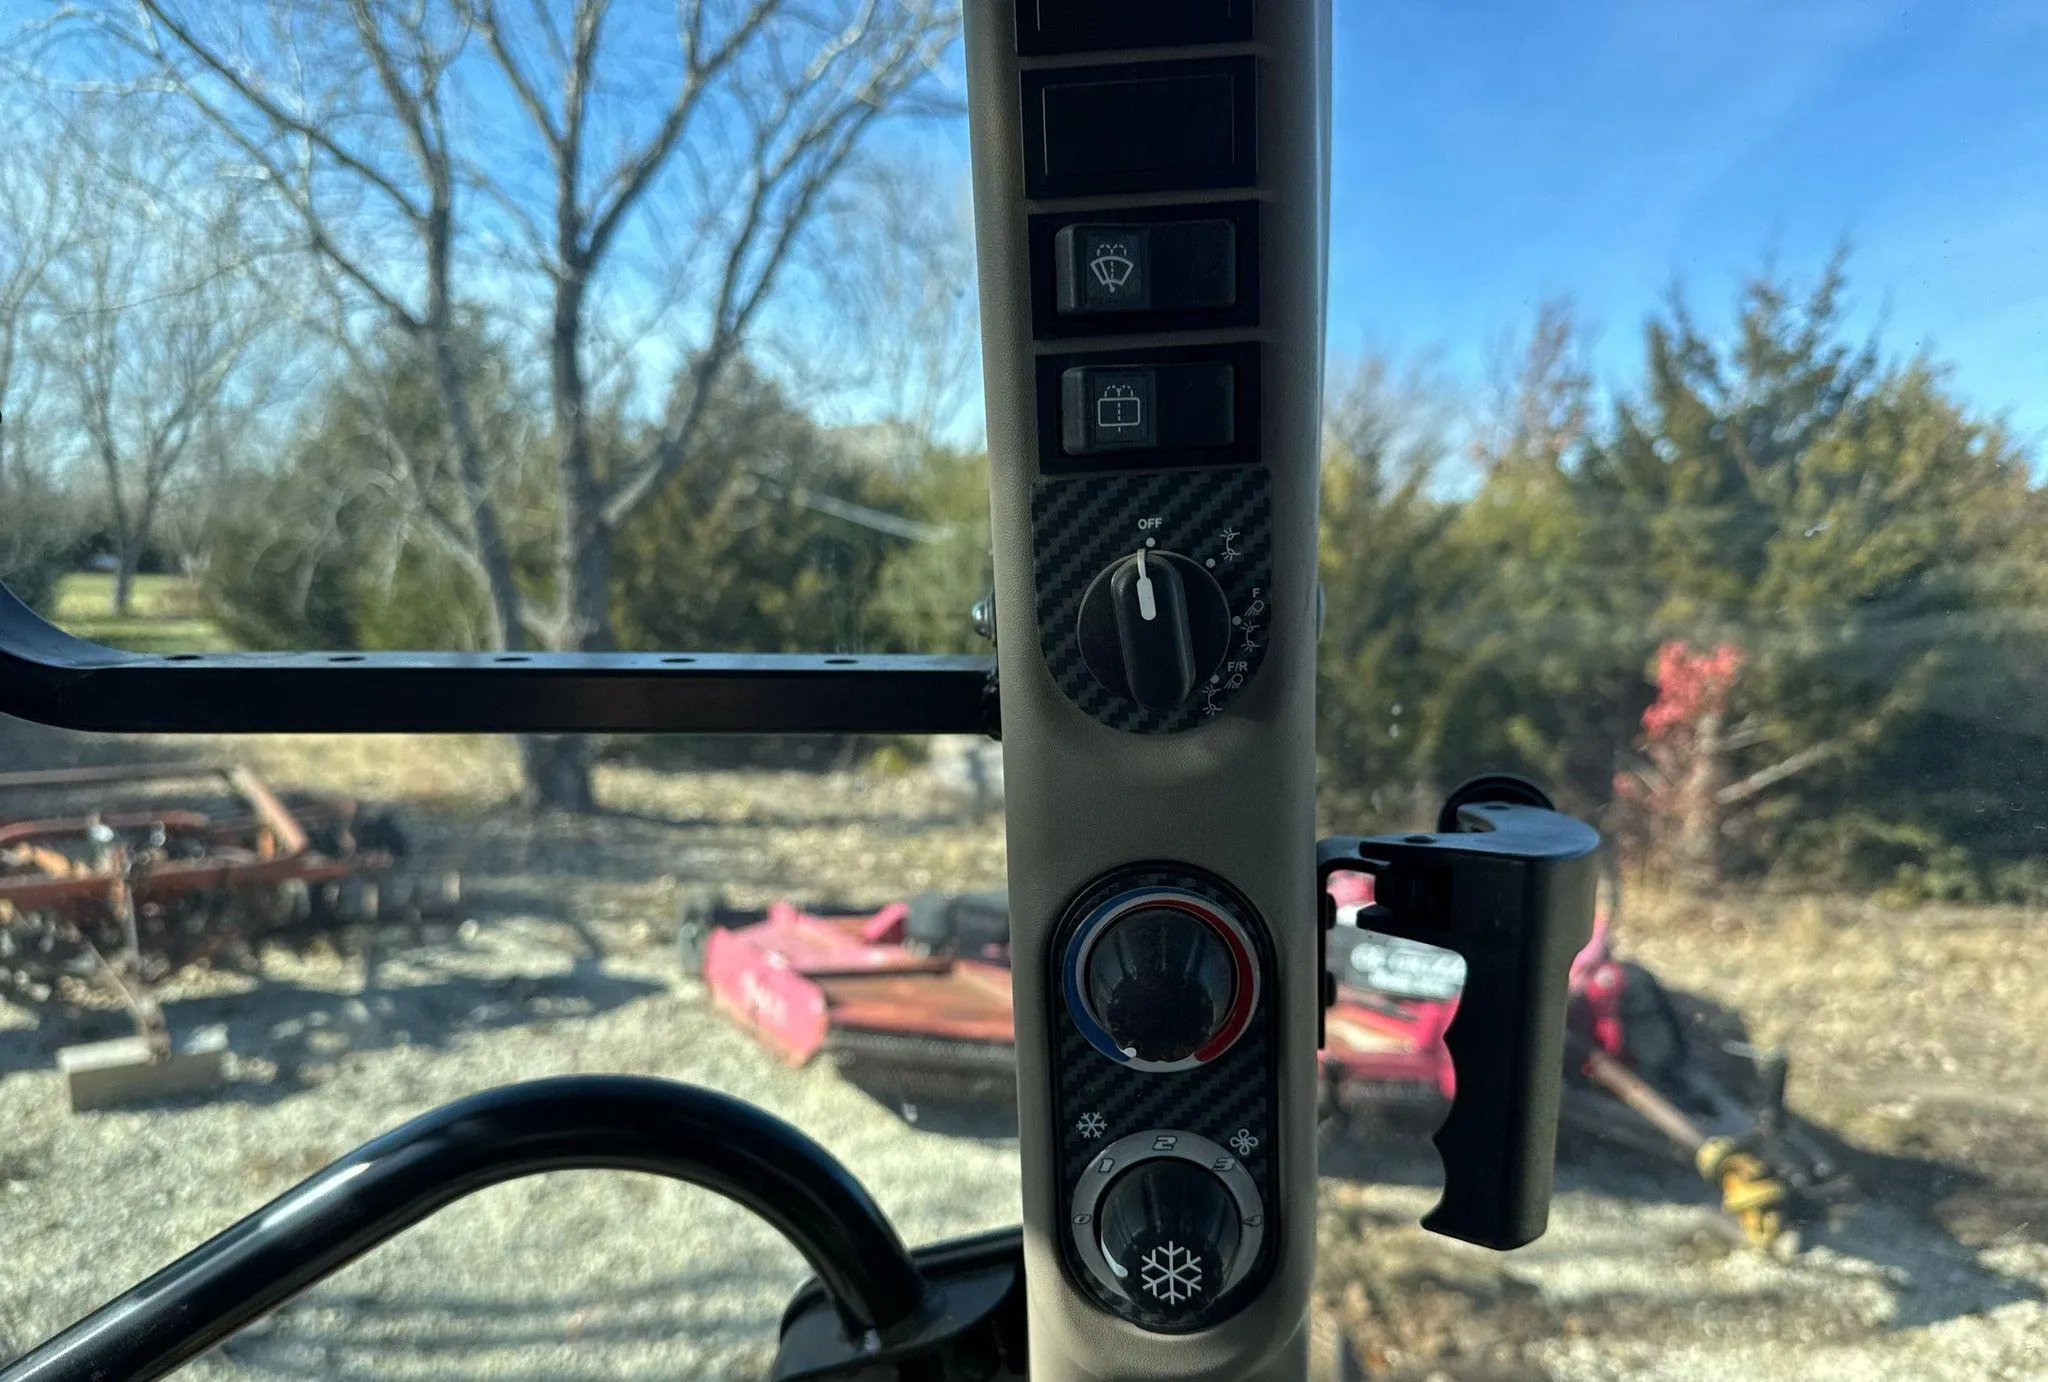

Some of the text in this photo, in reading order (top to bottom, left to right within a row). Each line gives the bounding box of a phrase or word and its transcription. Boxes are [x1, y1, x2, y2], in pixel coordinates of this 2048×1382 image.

[1138, 518, 1162, 530] OFF
[1252, 588, 1260, 598] F
[1227, 661, 1248, 672] F/R
[1152, 1136, 1178, 1151] 2
[1098, 1158, 1116, 1173] 1
[1211, 1157, 1237, 1172] 3
